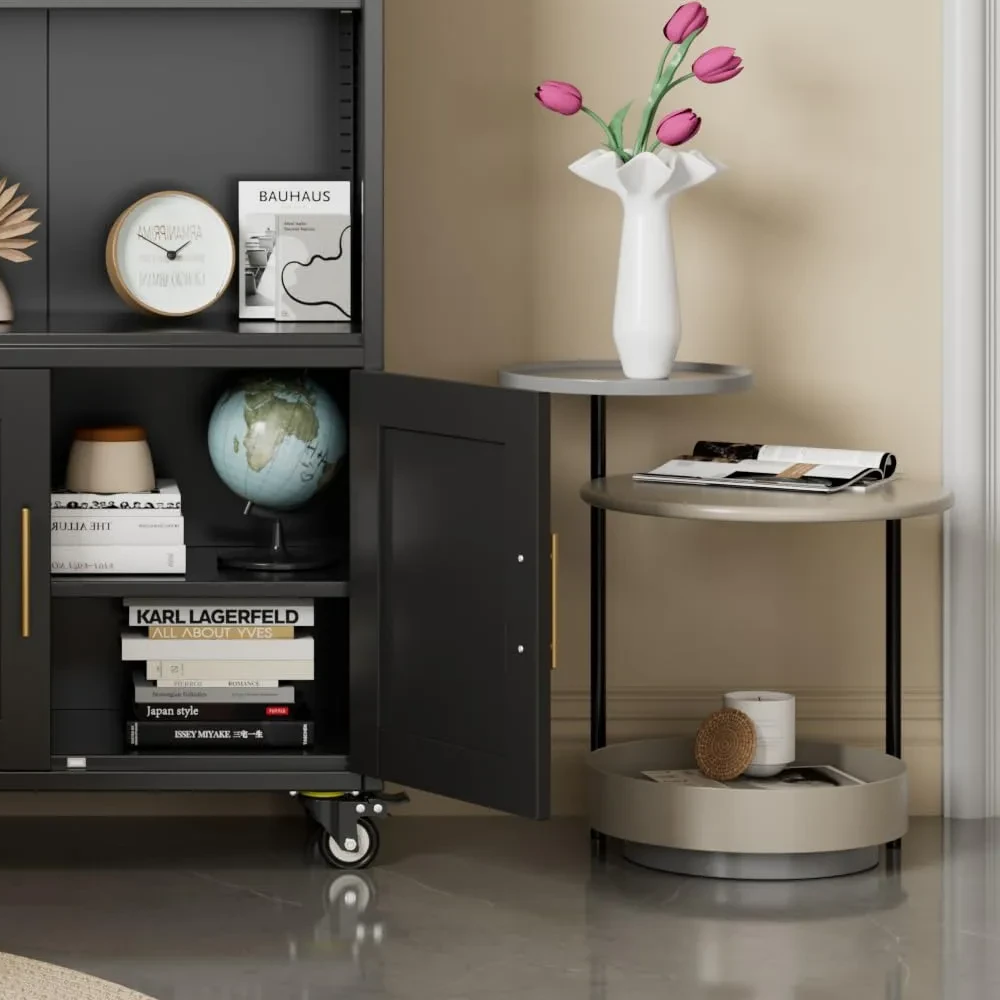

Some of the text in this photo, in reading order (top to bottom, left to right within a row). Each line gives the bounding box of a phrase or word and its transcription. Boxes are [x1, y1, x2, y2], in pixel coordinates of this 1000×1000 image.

[259, 191, 331, 202] BAUHAUS
[136, 609, 299, 624] KARL LAGERFELD
[151, 627, 273, 638] ALL ABOUT YVES
[147, 705, 199, 718] Japan style
[174, 730, 231, 739] ISSEY MIYAKE
